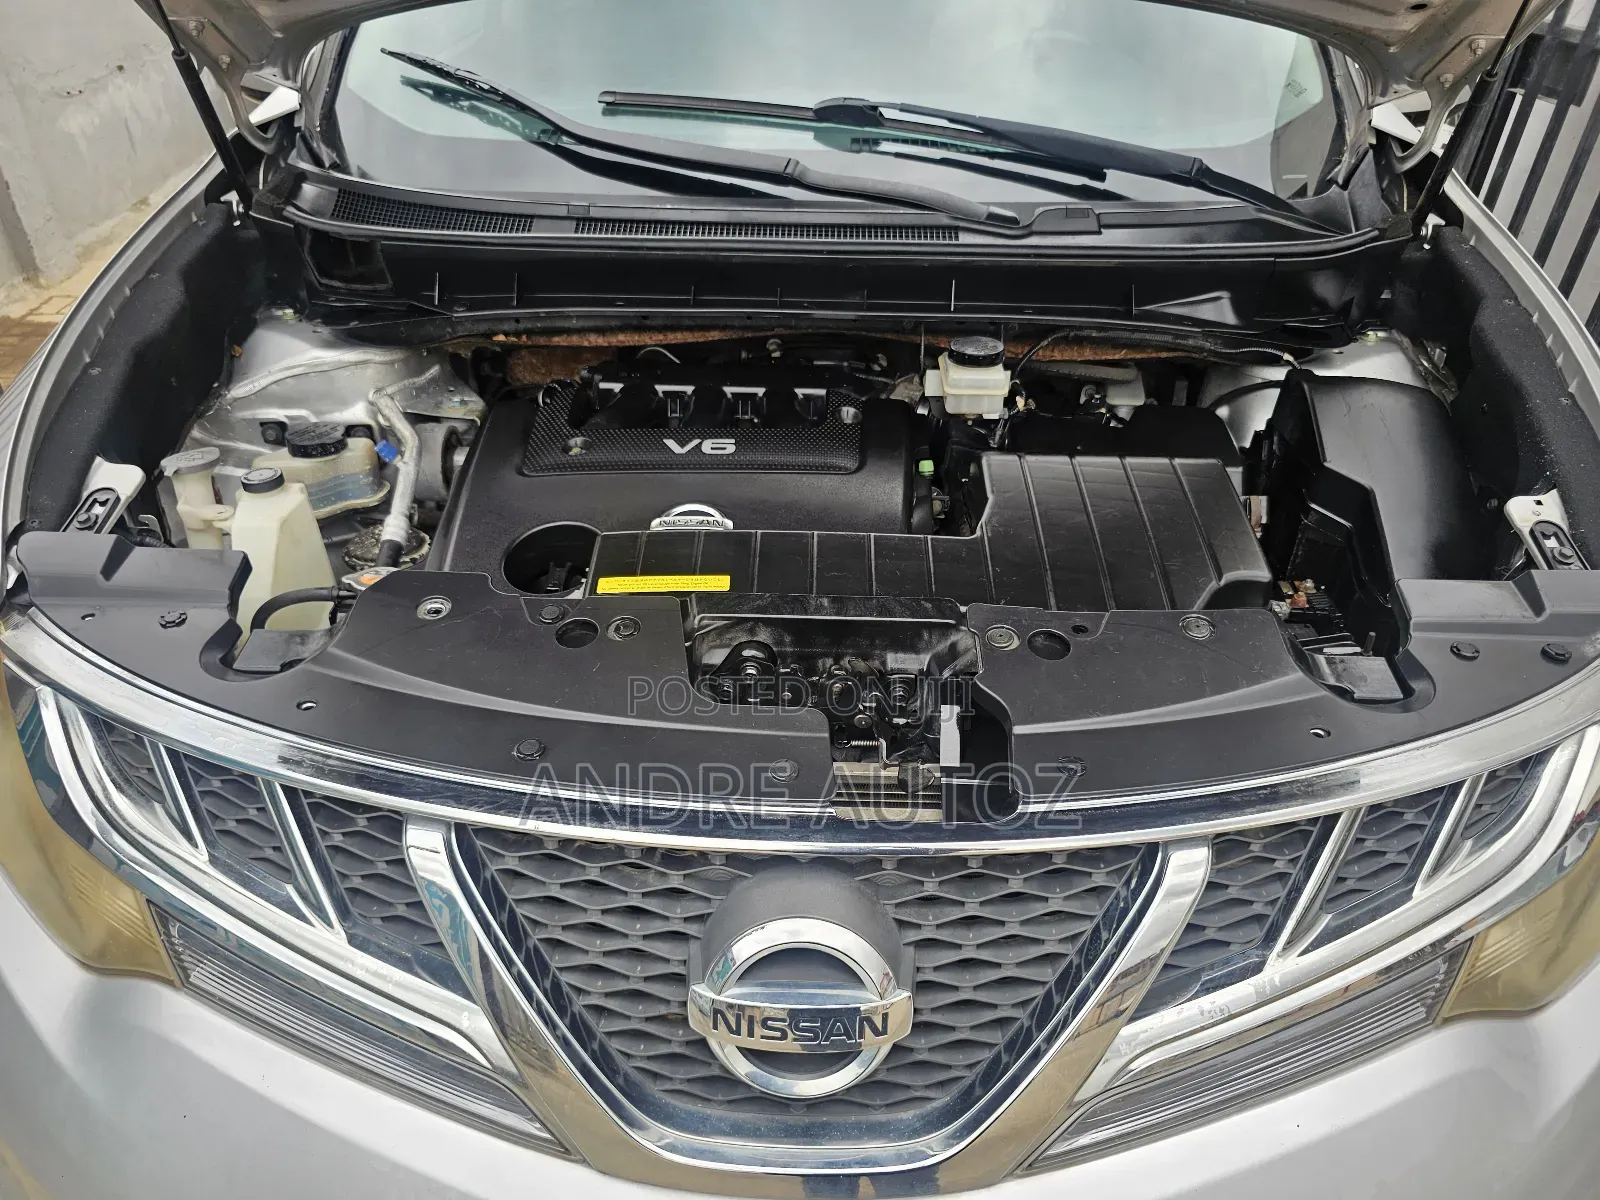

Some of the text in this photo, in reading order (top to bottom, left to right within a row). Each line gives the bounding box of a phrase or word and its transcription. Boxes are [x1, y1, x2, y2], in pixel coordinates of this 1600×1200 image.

[662, 438, 737, 455] V6
[659, 519, 725, 528] NISSAN
[711, 1006, 890, 1045] NISSAN
